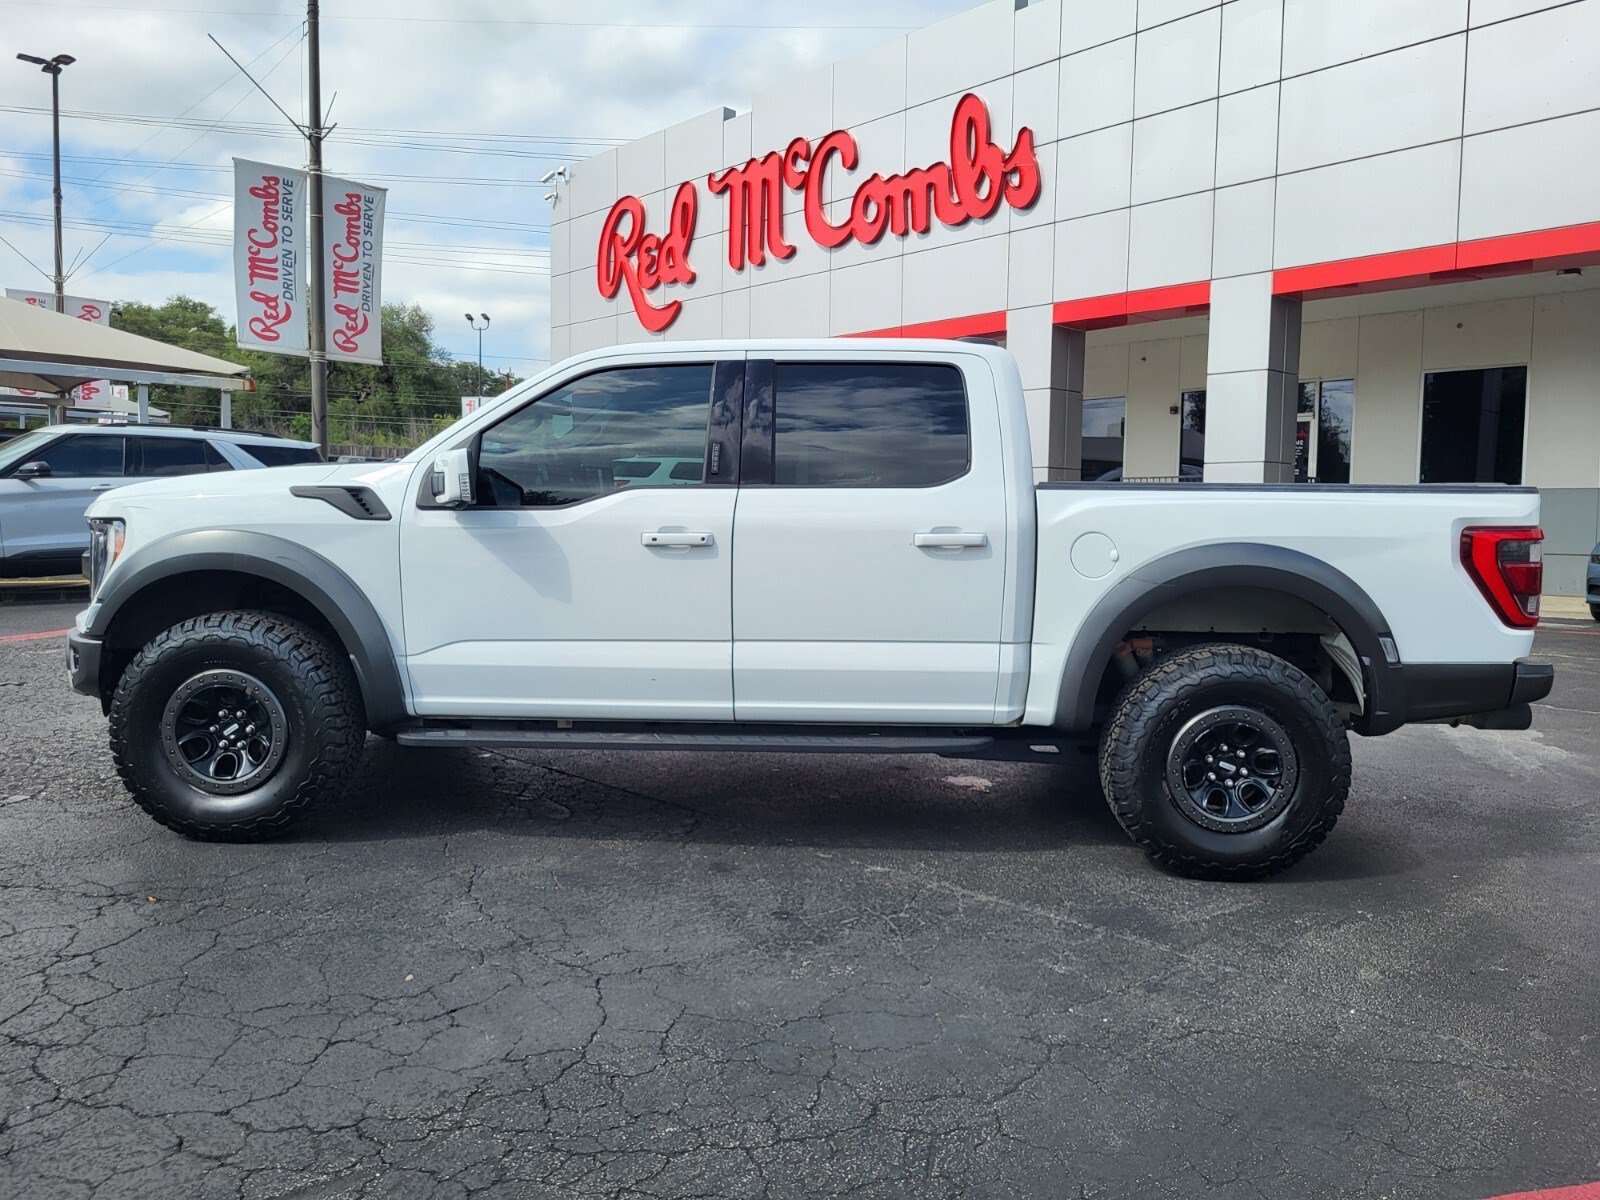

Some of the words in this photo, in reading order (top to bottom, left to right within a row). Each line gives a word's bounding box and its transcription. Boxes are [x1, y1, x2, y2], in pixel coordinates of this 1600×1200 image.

[281, 177, 294, 223] SERVE
[363, 195, 374, 237] SERVE
[596, 181, 698, 333] Red
[707, 93, 1042, 272] McCombs
[248, 175, 280, 286] McCombs
[282, 225, 293, 245] TO
[333, 192, 362, 299] McCombs
[362, 240, 373, 259] TO
[283, 249, 294, 301] DRIVEN
[361, 262, 372, 312] DRIVEN
[249, 290, 292, 342] Red
[333, 303, 369, 353] Red
